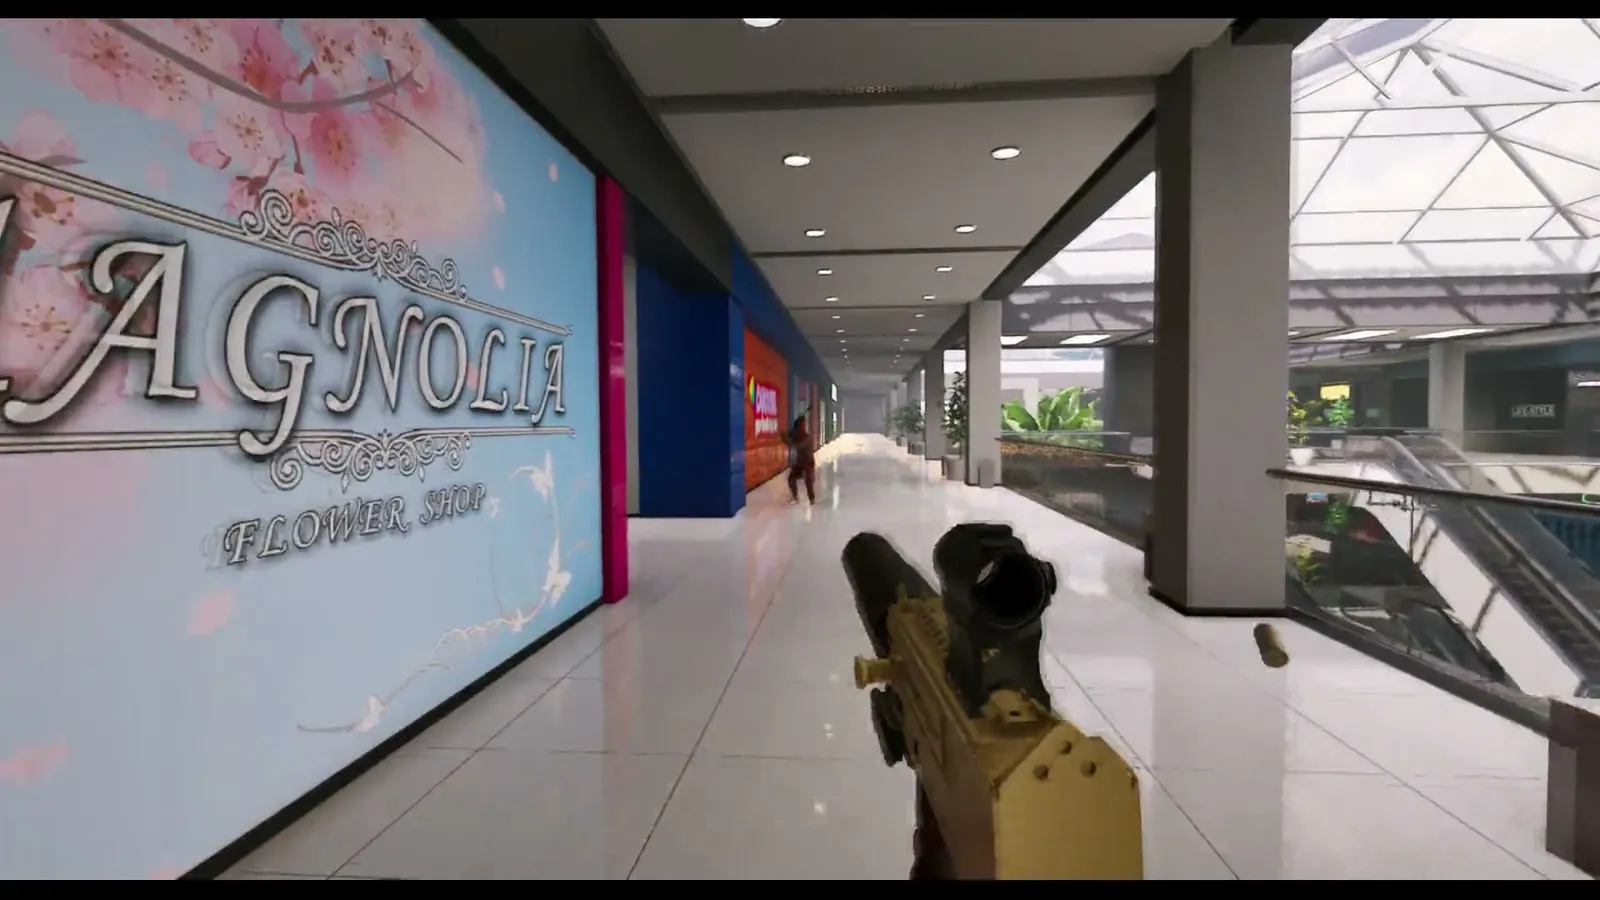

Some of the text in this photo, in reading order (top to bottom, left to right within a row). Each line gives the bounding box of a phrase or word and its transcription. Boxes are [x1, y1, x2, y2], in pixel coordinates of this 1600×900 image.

[0, 197, 567, 456] AGNOLIA
[223, 483, 487, 566] FLOWER SHOP
